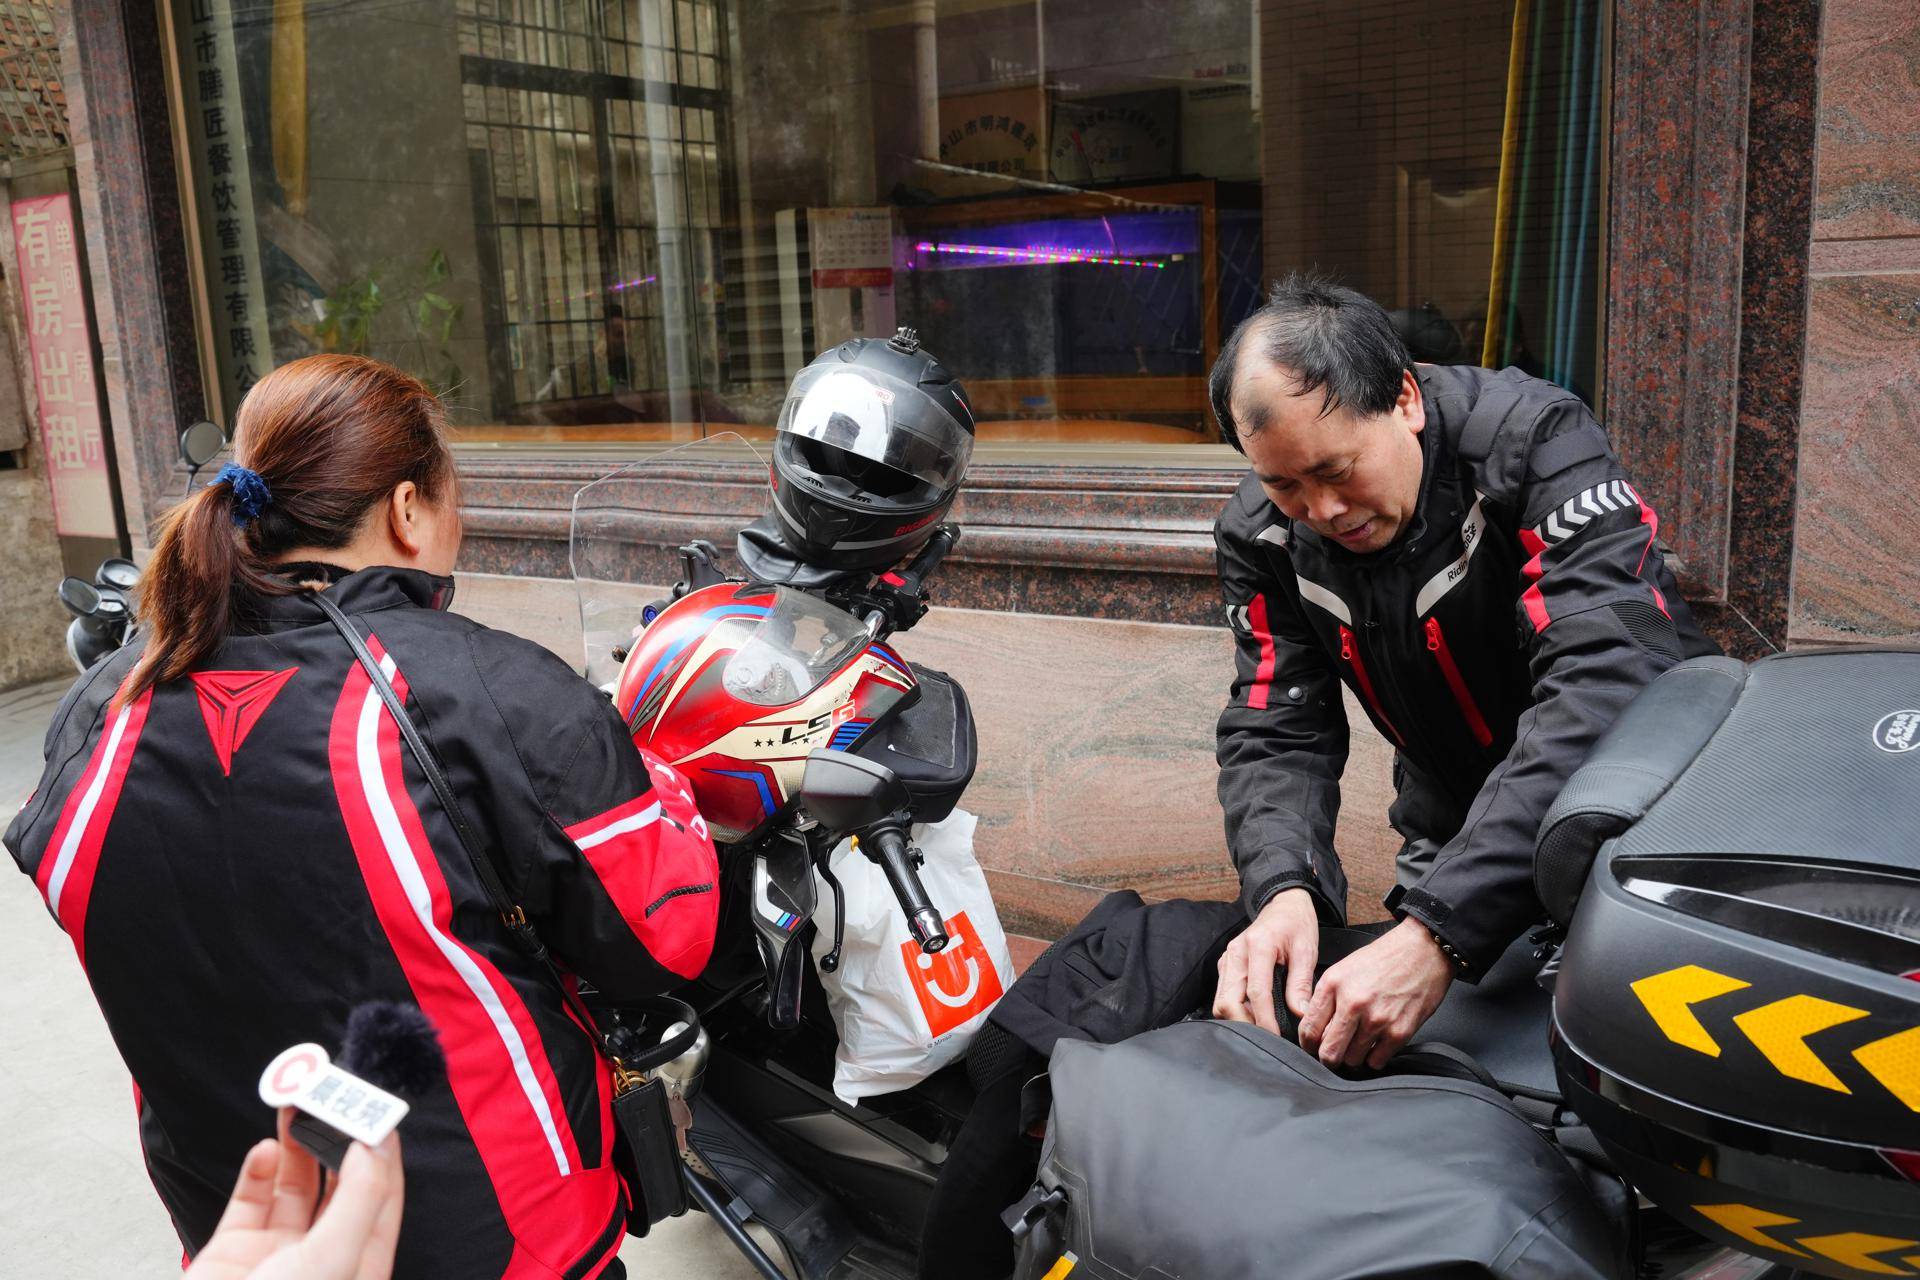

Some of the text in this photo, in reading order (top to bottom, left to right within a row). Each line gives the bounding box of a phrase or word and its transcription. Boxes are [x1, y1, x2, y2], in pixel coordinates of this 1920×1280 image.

[16, 207, 87, 471] 有房出租
[54, 220, 102, 464] 单间一房一厅
